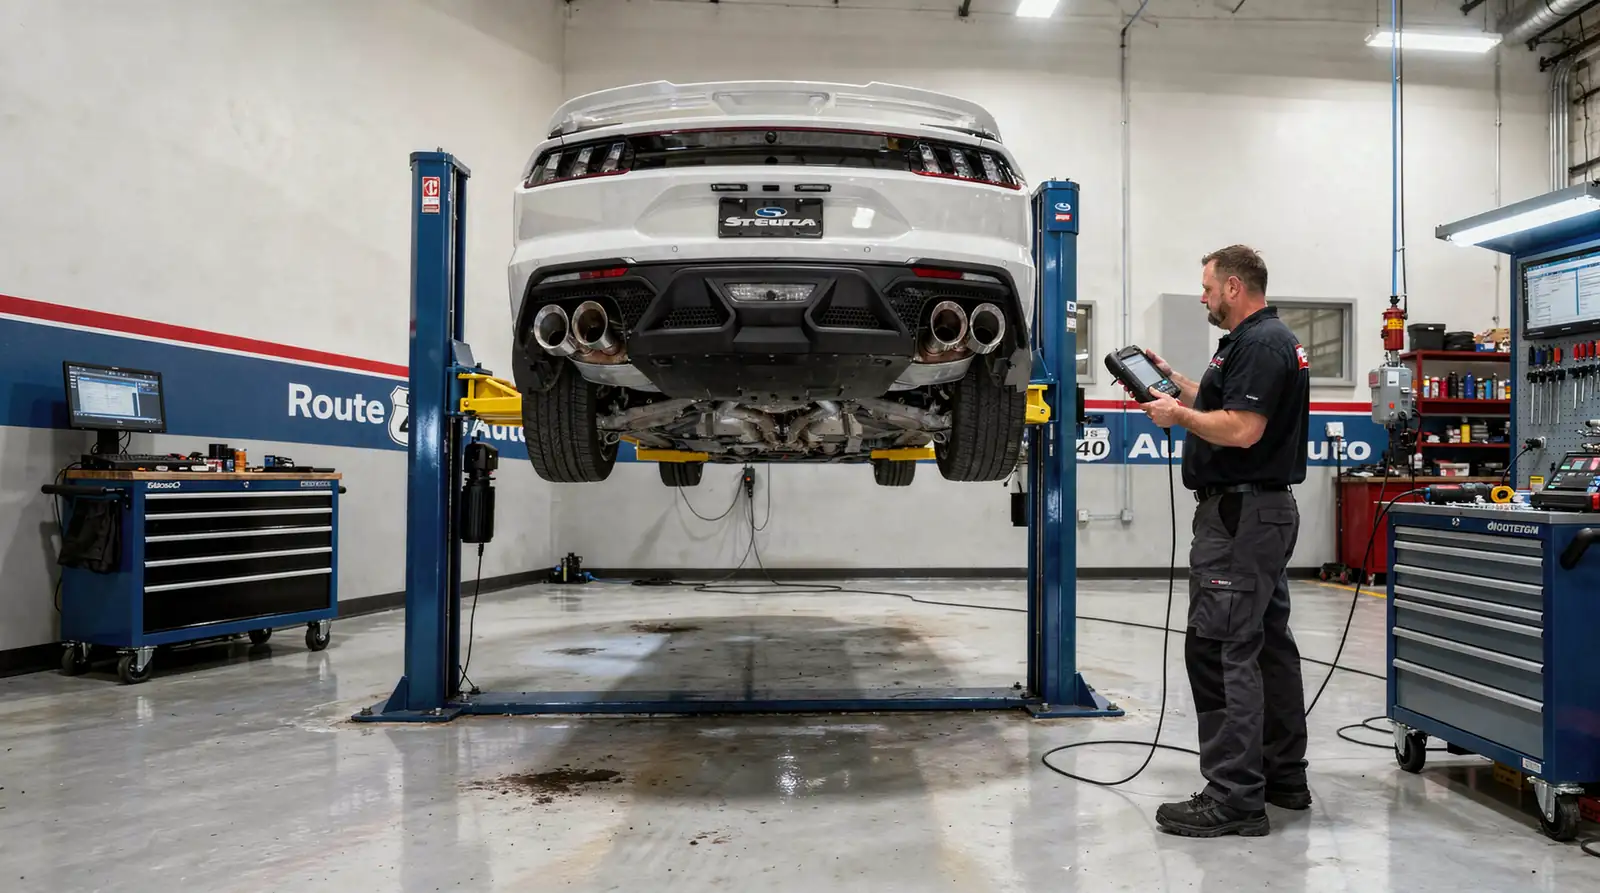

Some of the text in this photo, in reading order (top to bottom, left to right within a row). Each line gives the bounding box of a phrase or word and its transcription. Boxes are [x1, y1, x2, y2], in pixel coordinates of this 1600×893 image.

[288, 382, 385, 424] Route
[1076, 441, 1105, 456] 40
[1307, 438, 1371, 461] uto
